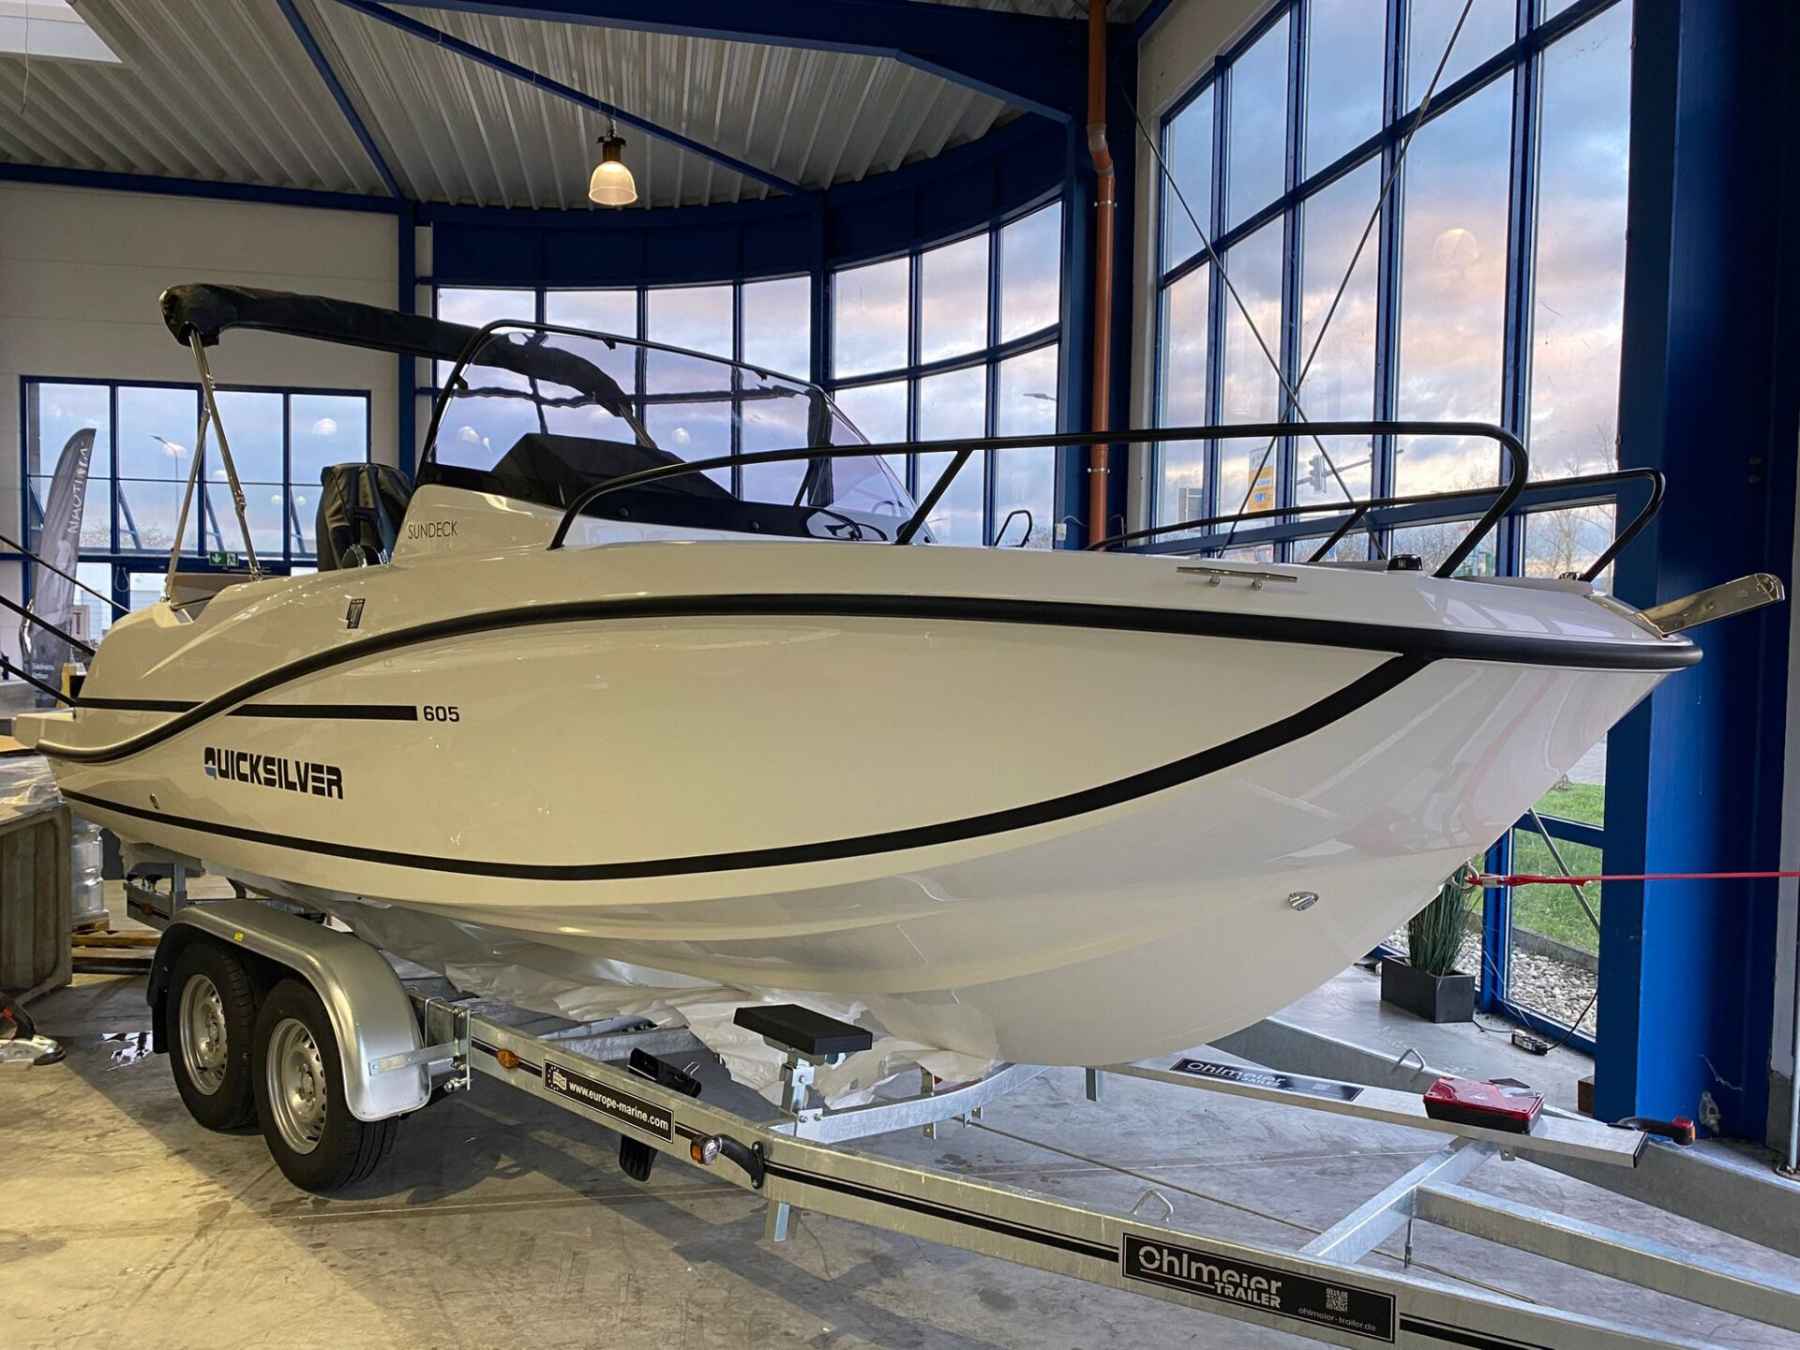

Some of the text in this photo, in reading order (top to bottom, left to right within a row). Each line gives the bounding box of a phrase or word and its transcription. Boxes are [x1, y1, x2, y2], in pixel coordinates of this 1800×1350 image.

[408, 520, 457, 539] SUNDECK
[423, 705, 460, 722] 605
[204, 747, 343, 800] QUICKSILVER
[1187, 1062, 1287, 1085] Ohlmeier
[568, 1081, 669, 1130] www.europe-marine.com
[1139, 1245, 1282, 1293] Ohlmeier
[1214, 1282, 1281, 1309] TRAILER
